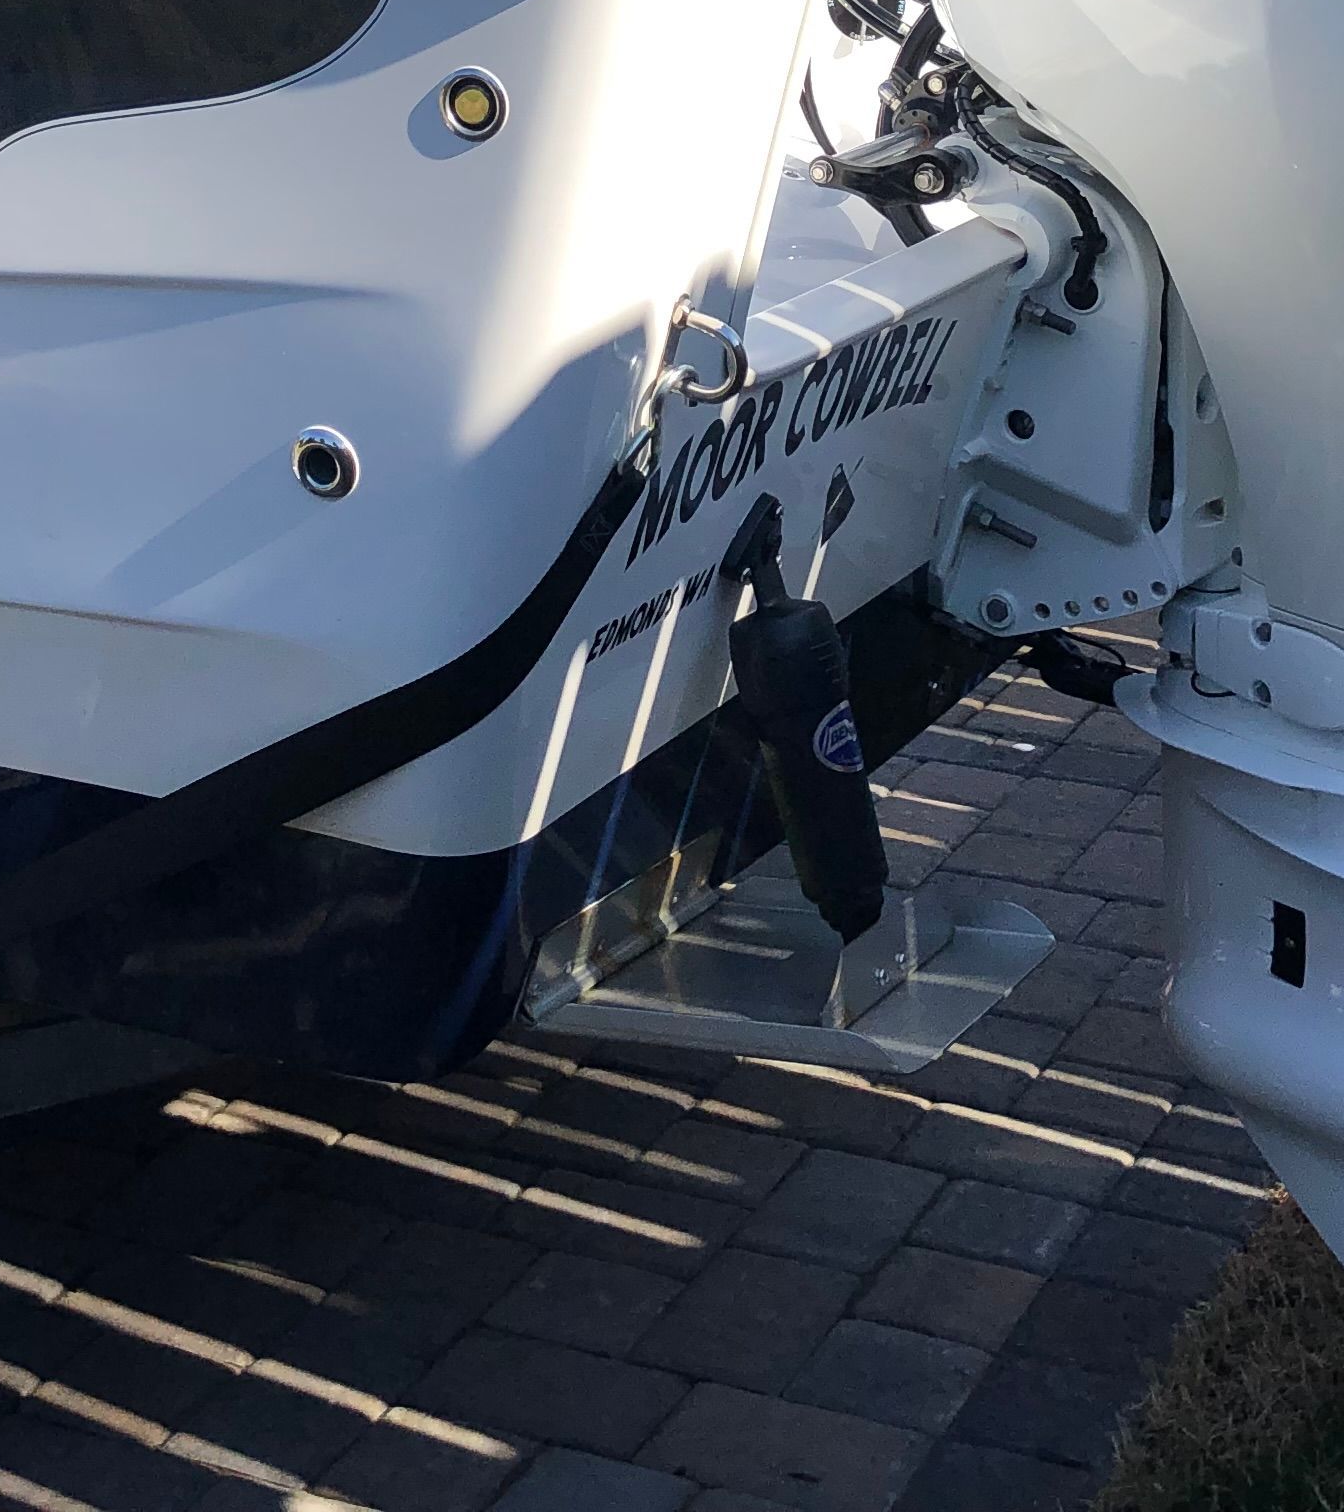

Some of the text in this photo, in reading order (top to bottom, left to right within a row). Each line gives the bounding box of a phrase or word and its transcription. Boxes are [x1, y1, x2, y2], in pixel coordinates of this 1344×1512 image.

[624, 317, 958, 572] MOOR COWBELL
[585, 563, 717, 665] EDMONDS WA
